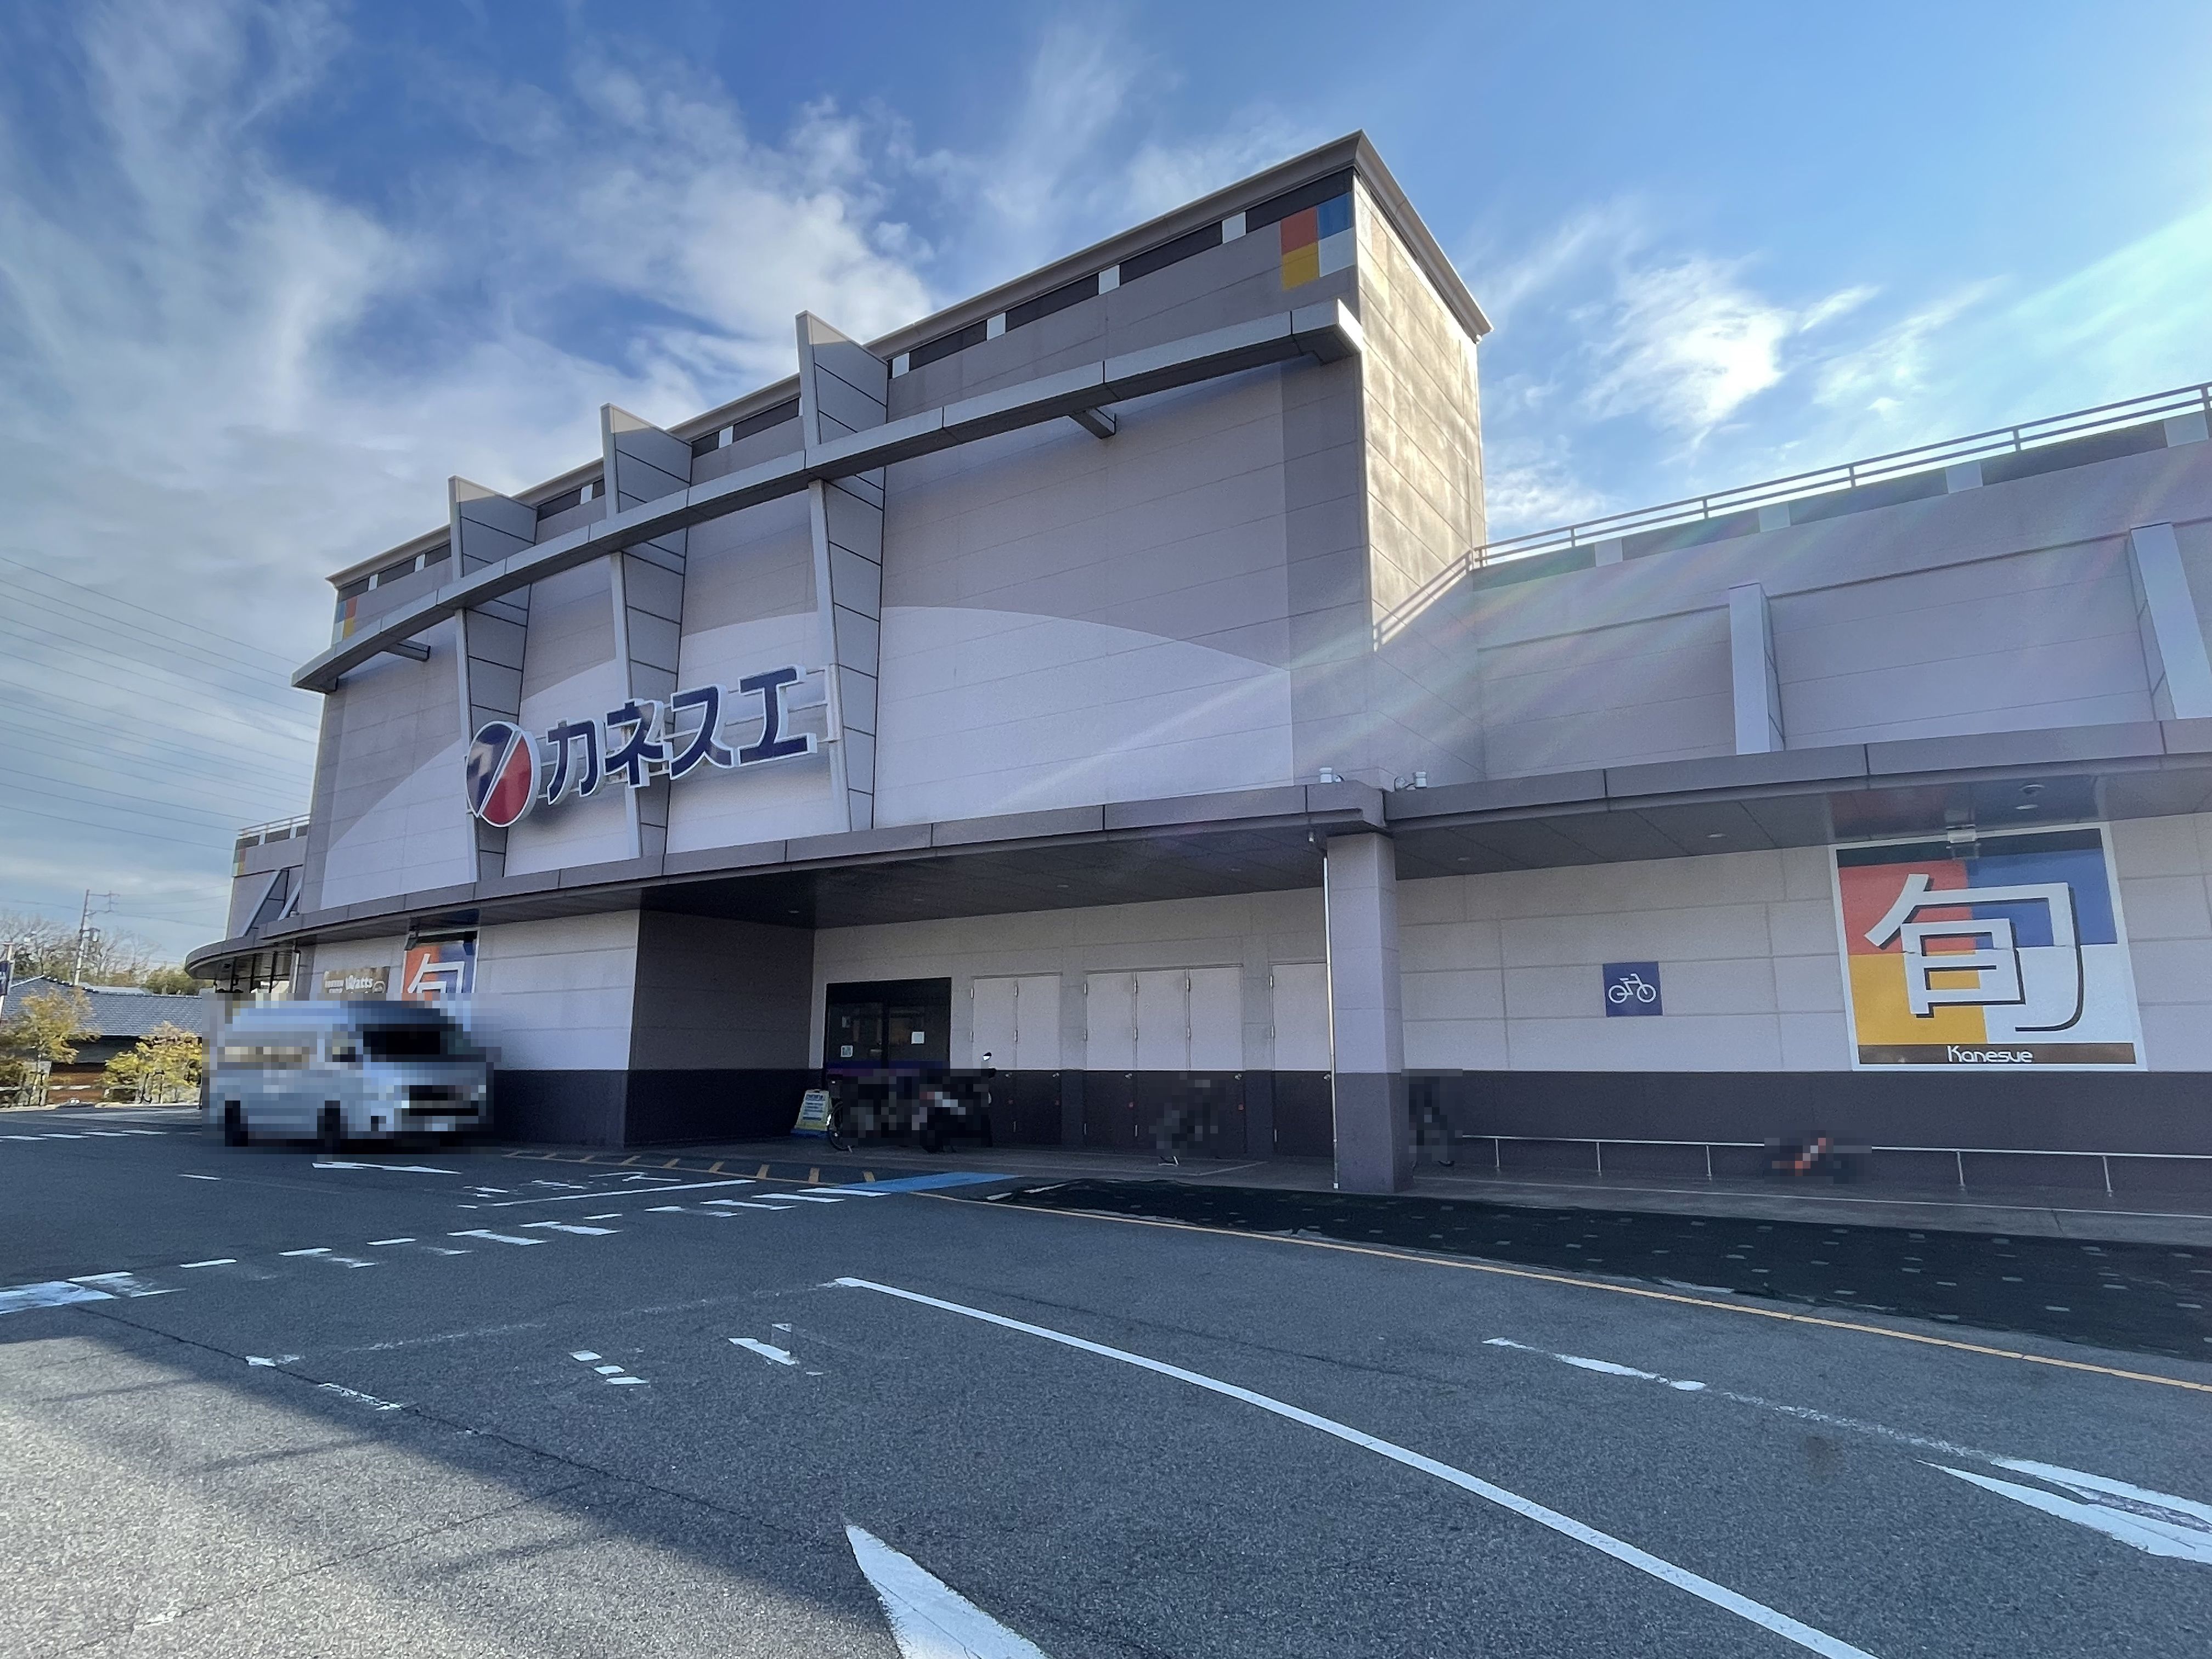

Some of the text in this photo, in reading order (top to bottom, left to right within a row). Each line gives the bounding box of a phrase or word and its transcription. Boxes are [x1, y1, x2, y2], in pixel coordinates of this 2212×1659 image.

[547, 664, 817, 805] カネスエ
[1864, 873, 2083, 1031] 旬
[1948, 1046, 2033, 1062] Kanesue
